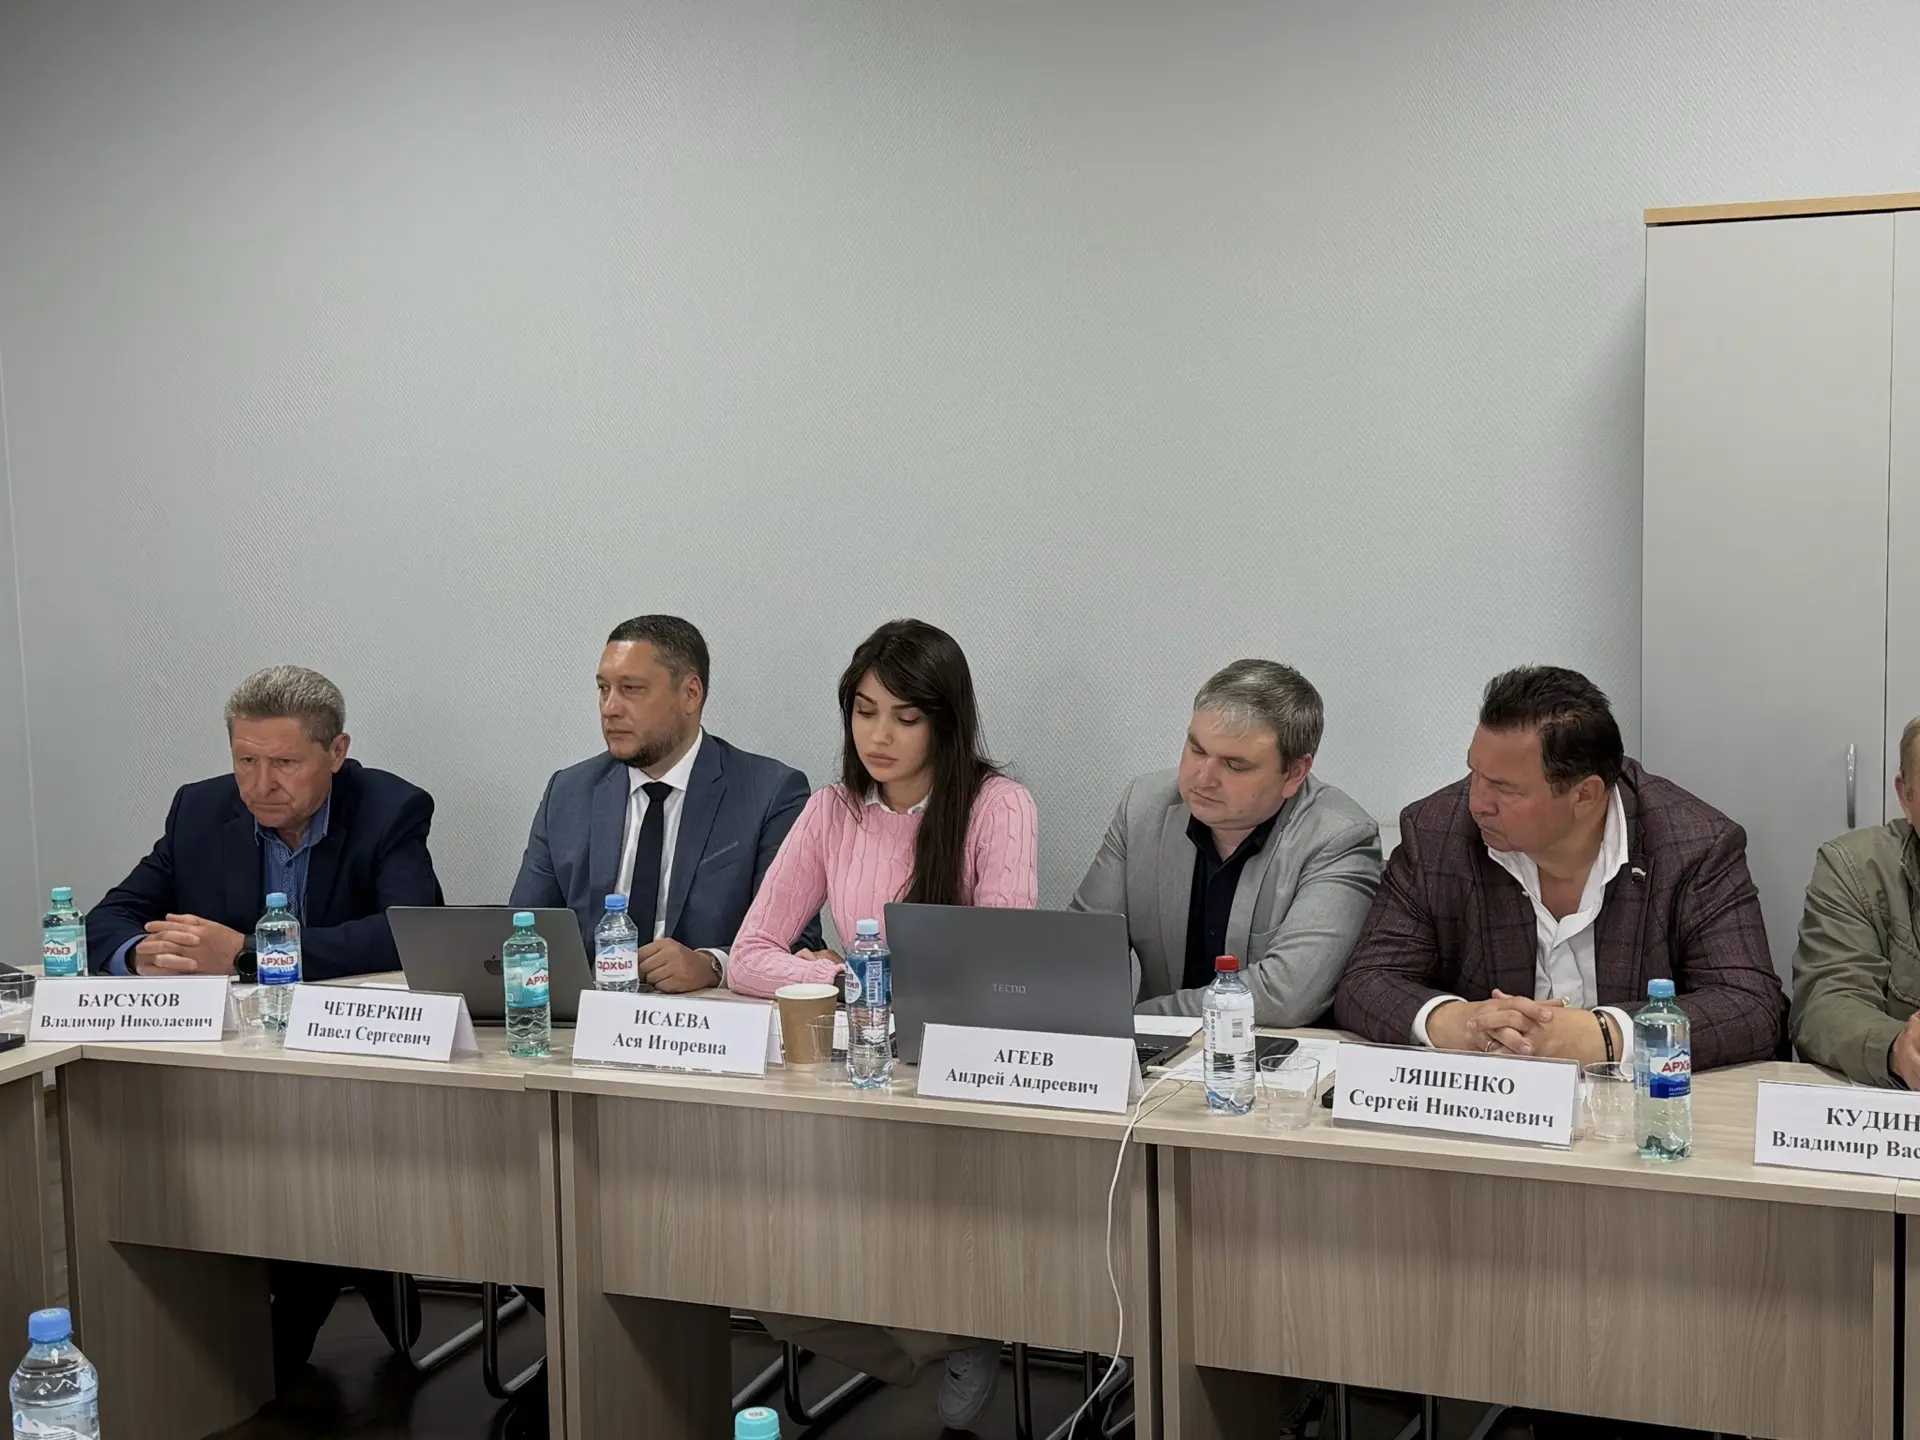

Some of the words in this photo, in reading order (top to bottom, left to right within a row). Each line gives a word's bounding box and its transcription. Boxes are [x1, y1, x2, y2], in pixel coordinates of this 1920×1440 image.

[260, 955, 295, 966] АРХЫЗ
[596, 959, 633, 973] архыз
[78, 993, 181, 1008] БАРСУКОВ
[324, 1000, 424, 1022] ЧЕТВЕРКИН
[40, 1015, 116, 1032] Владимир
[120, 1014, 213, 1029] Николаевич
[634, 1009, 711, 1030] ИСАЕВА
[307, 1022, 351, 1040] Павел
[355, 1026, 432, 1047] Сергеевич
[613, 1033, 644, 1049] Ася
[648, 1034, 727, 1057] Игоревна
[993, 1048, 1055, 1067] АГЕЕВ
[945, 1067, 1006, 1088] Андрей
[1009, 1072, 1099, 1094] Андреевич
[1389, 1066, 1515, 1096] ЛЯШЕНКО
[1348, 1089, 1419, 1114] Сергей
[1424, 1098, 1555, 1130] Николаевич
[1826, 1107, 1920, 1133] КУДИН
[1771, 1130, 1880, 1160] Владимир
[1886, 1140, 1920, 1160] Вас
